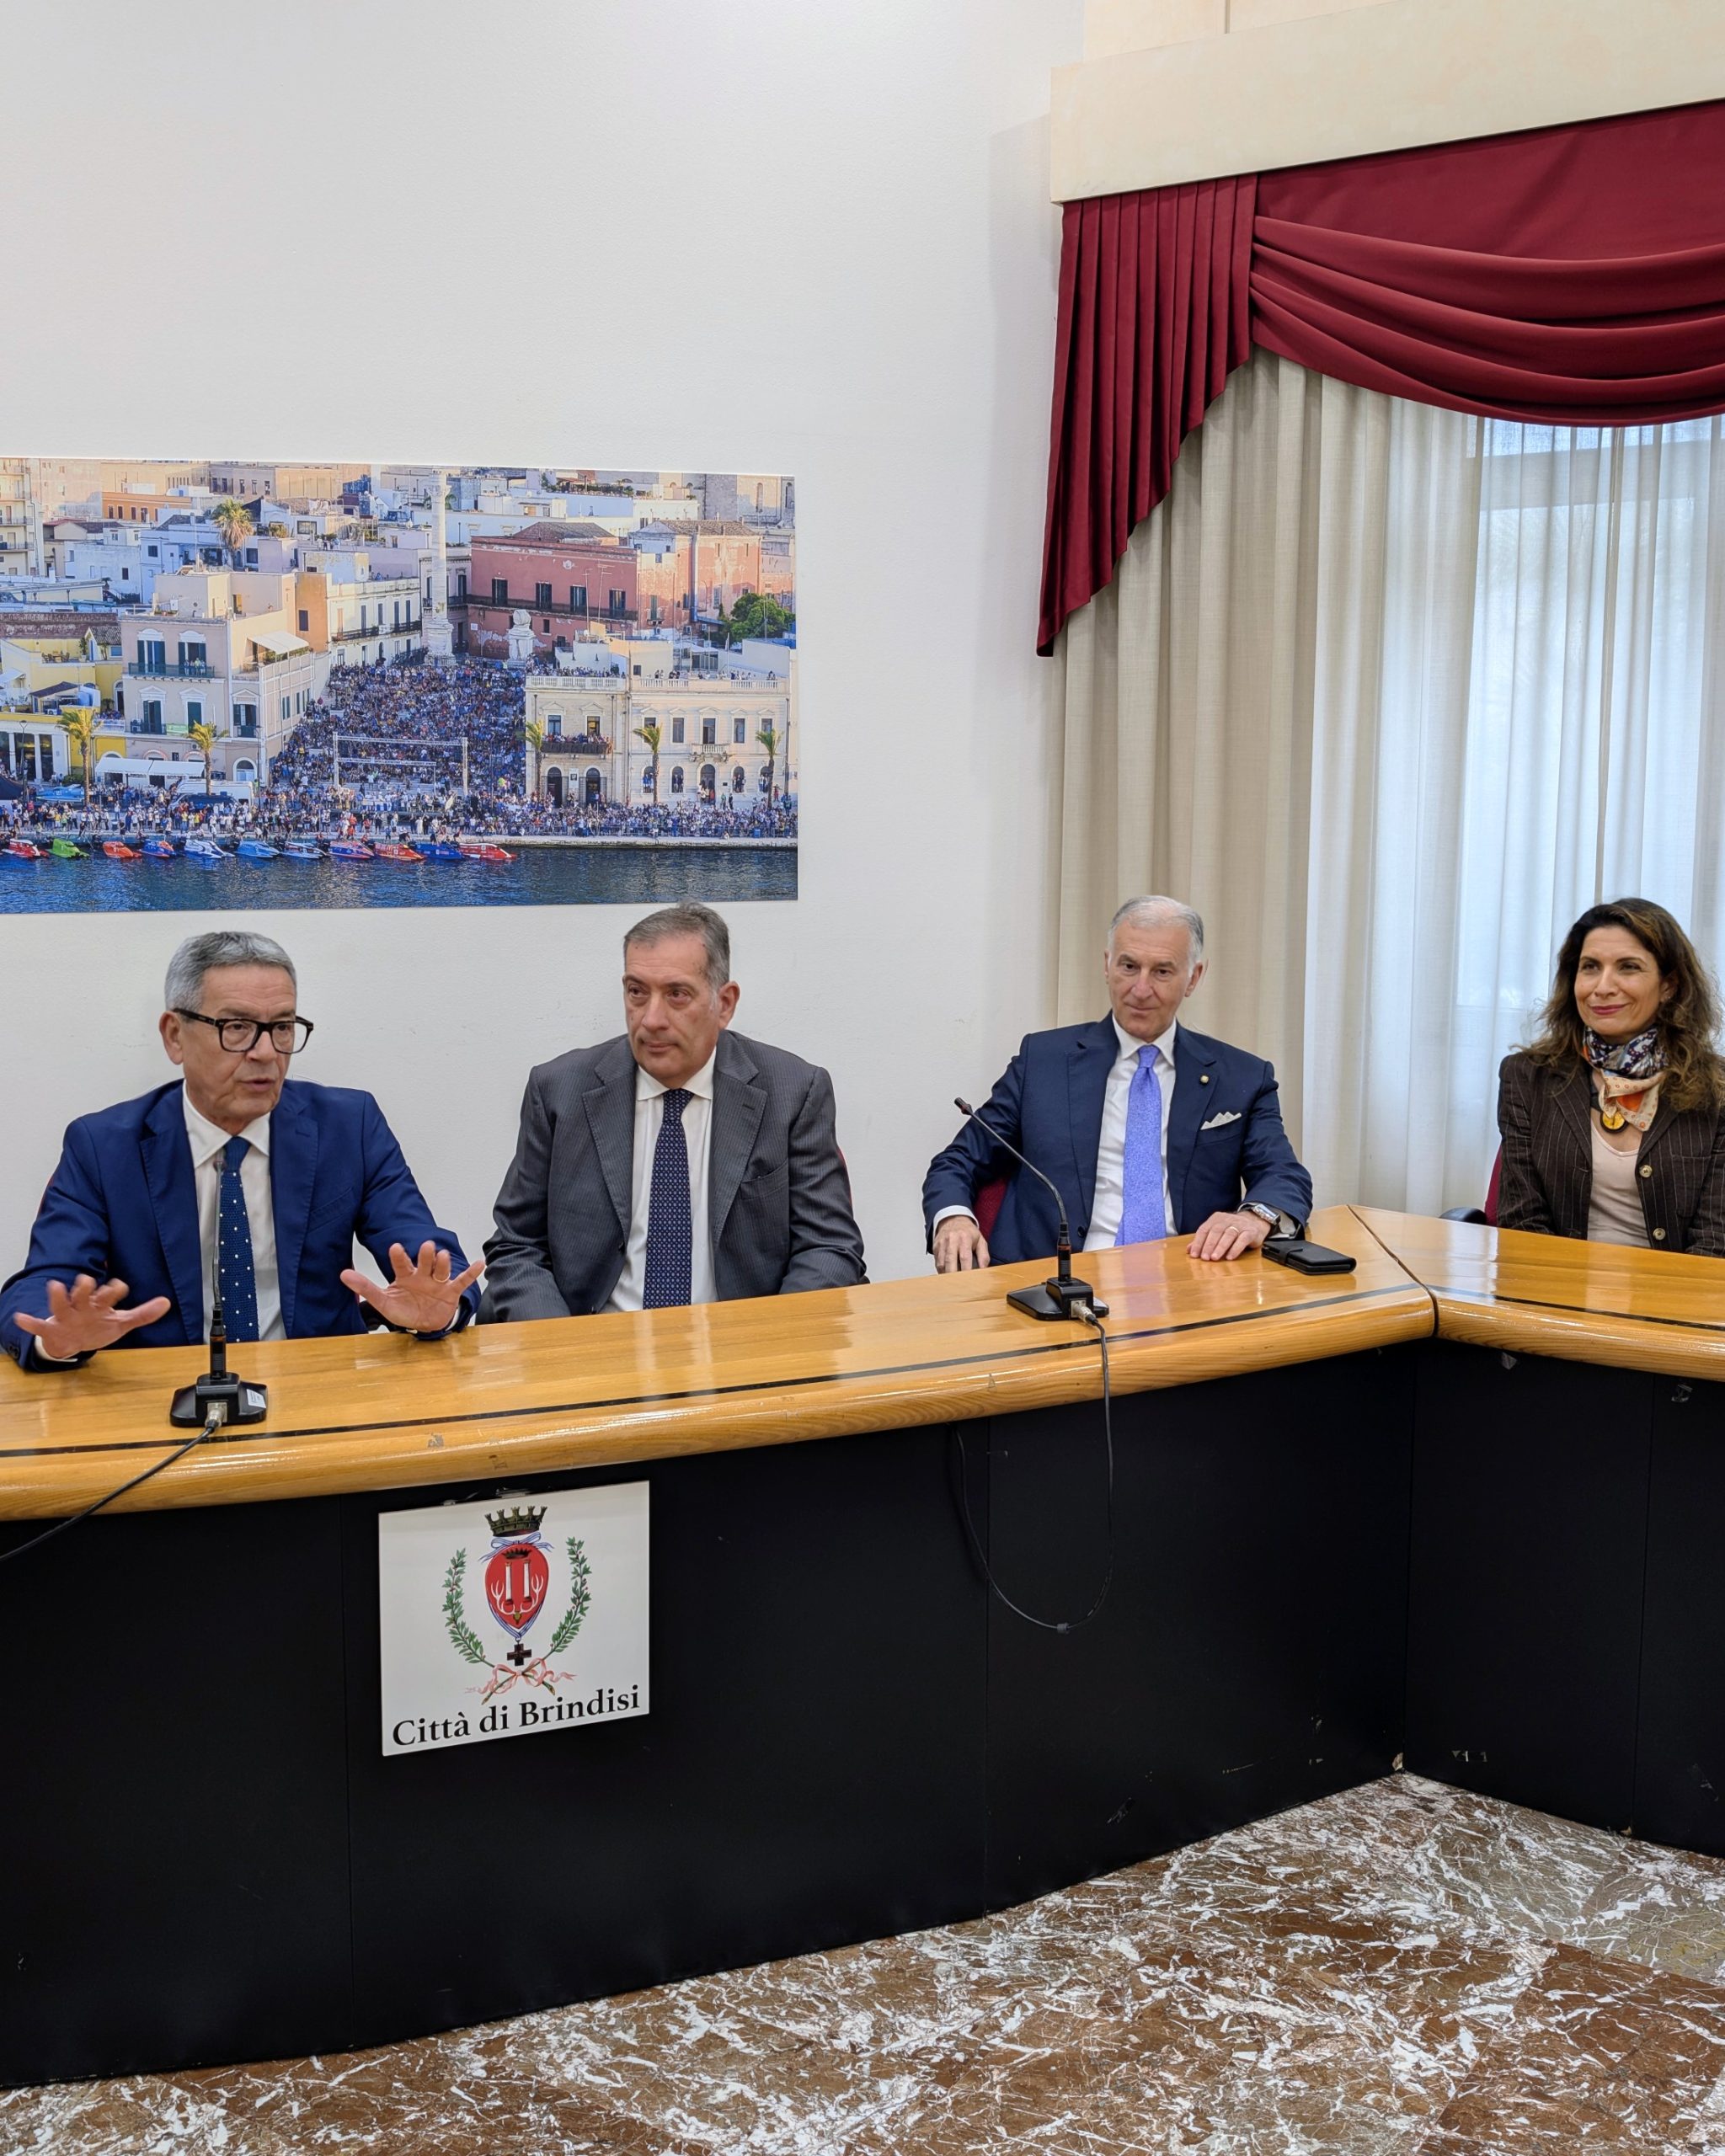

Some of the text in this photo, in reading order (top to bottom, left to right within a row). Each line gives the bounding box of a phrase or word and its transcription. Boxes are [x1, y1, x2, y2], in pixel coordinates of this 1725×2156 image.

[393, 1684, 640, 1746] Città di Brindisi
